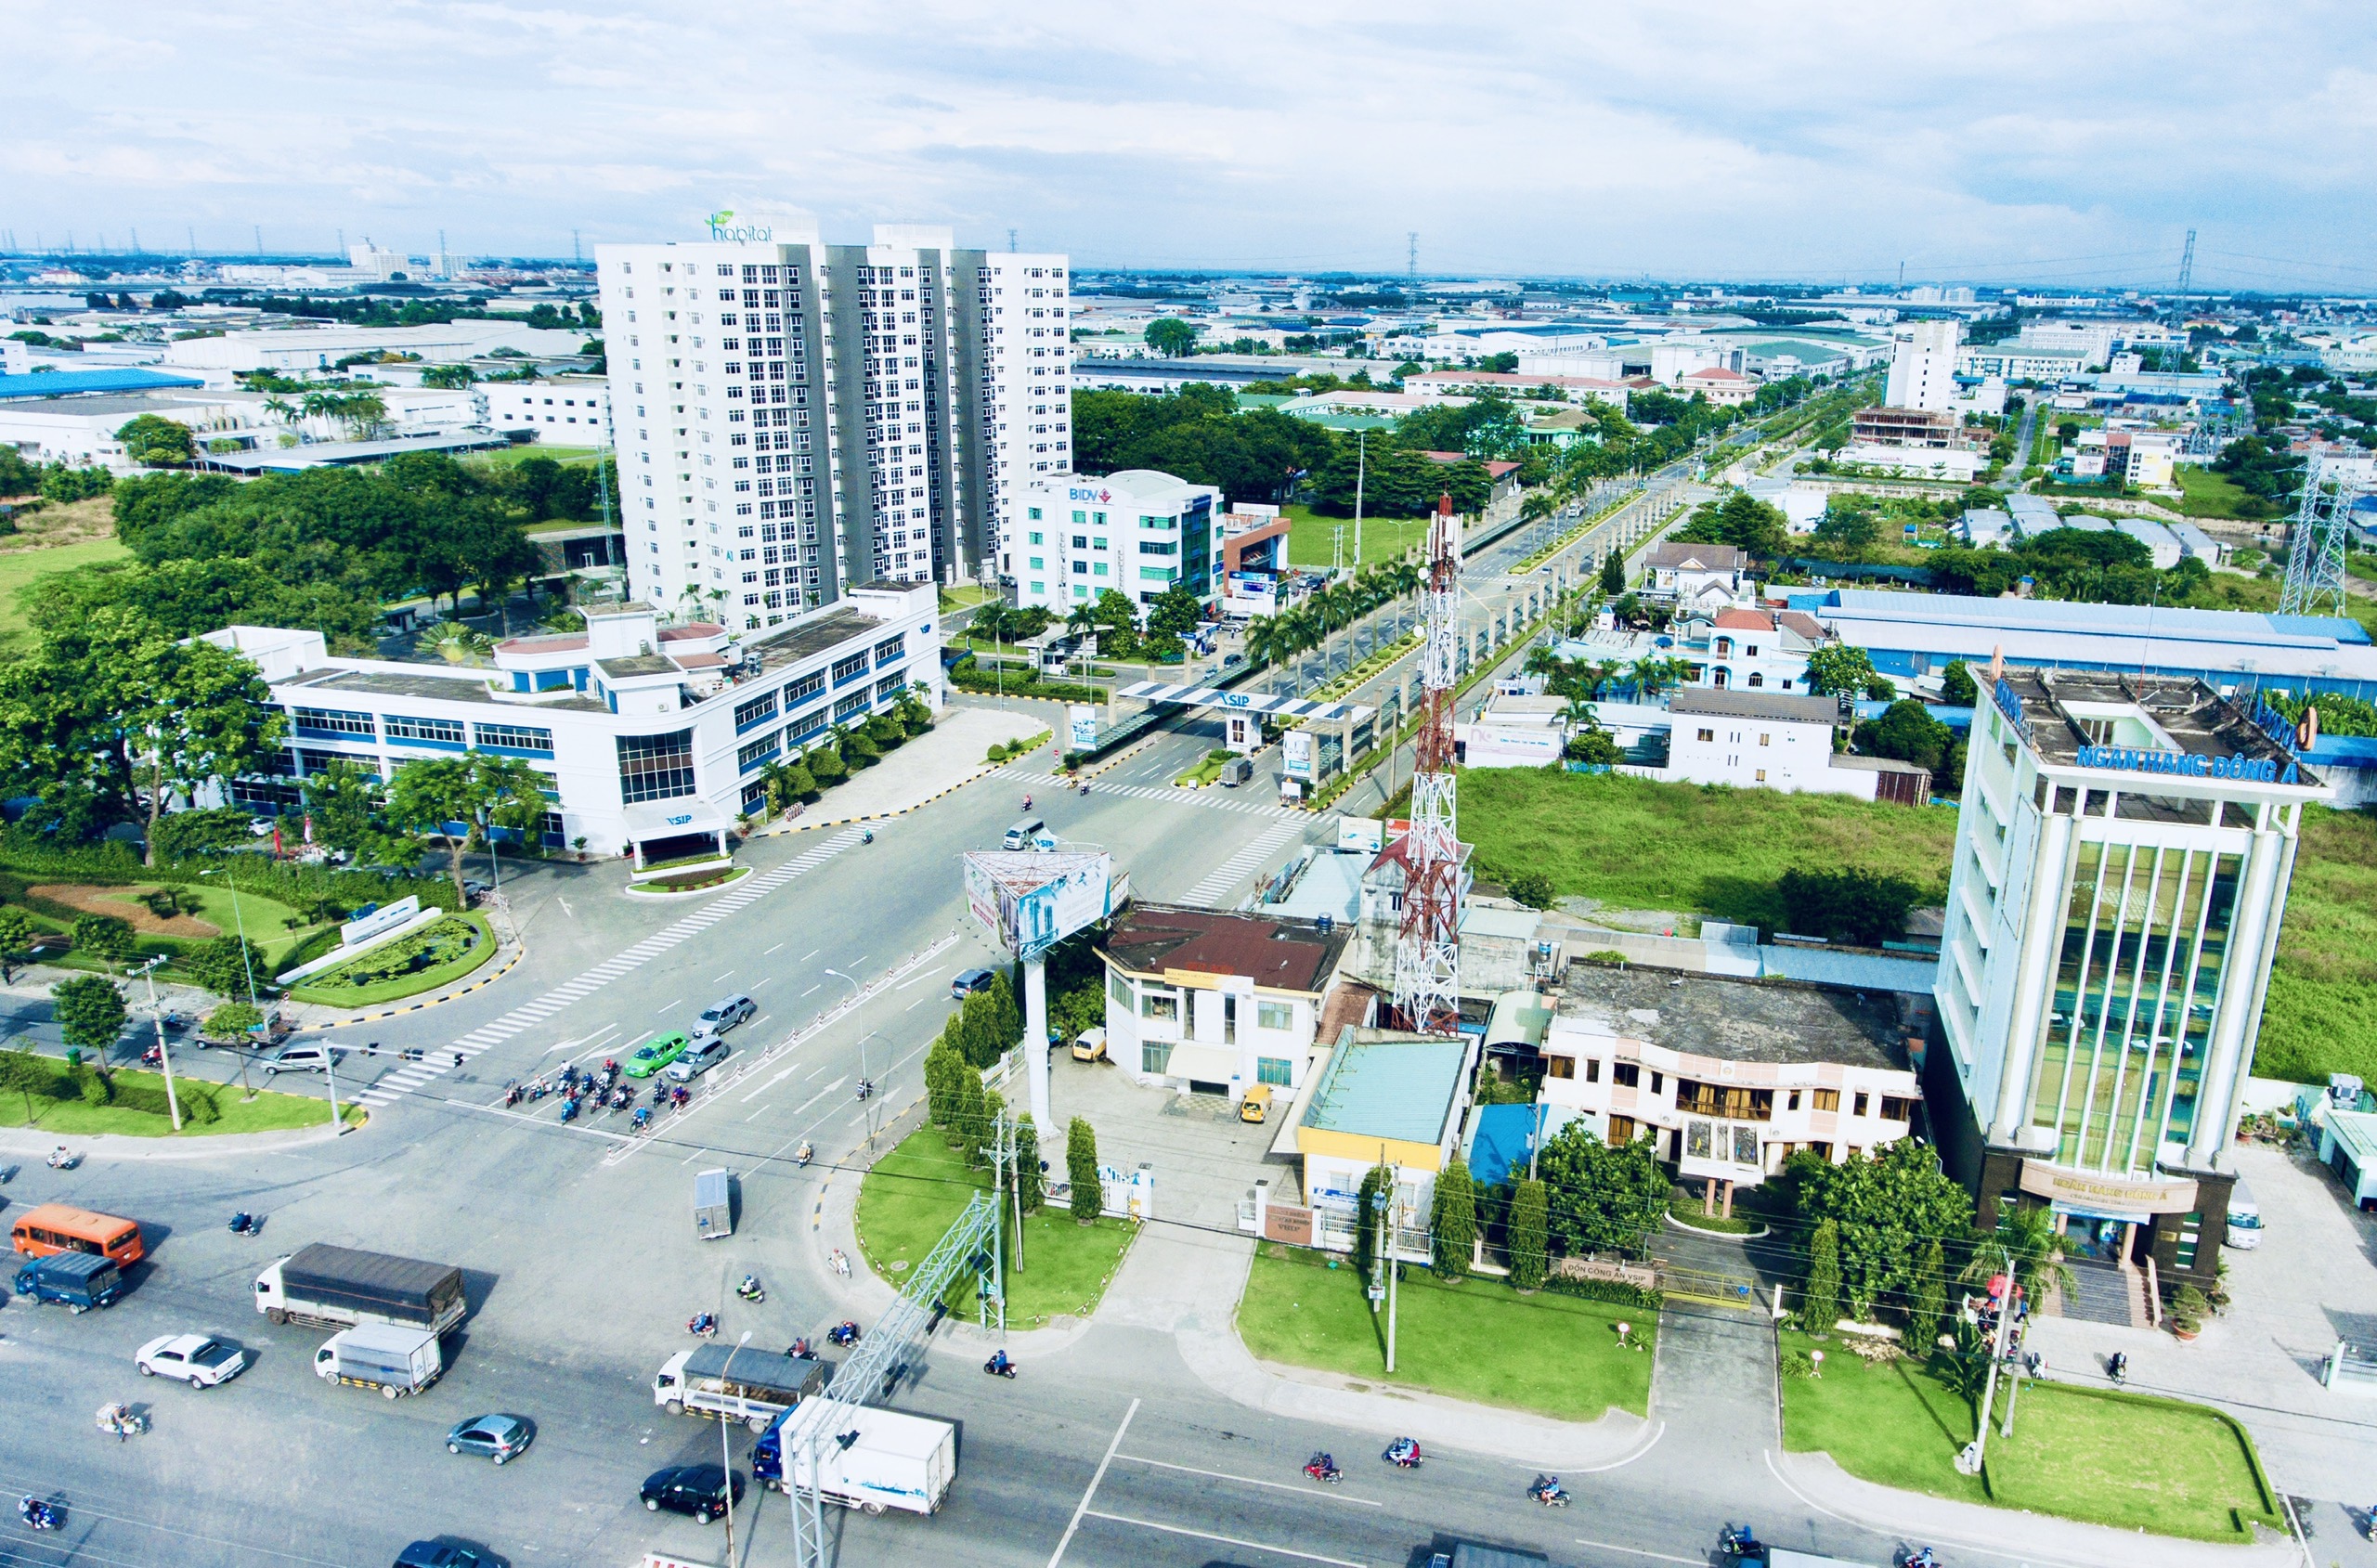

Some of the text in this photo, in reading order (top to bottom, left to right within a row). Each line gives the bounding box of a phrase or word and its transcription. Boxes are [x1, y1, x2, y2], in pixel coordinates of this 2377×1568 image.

[711, 214, 773, 242] habitat
[1070, 487, 1098, 501] BIDV
[1218, 691, 1250, 706] VSIP
[2076, 743, 2140, 771] NGÂN
[2142, 747, 2208, 777] HÀNG
[2212, 752, 2278, 784] ĐÔNG
[666, 814, 693, 825] VSIP
